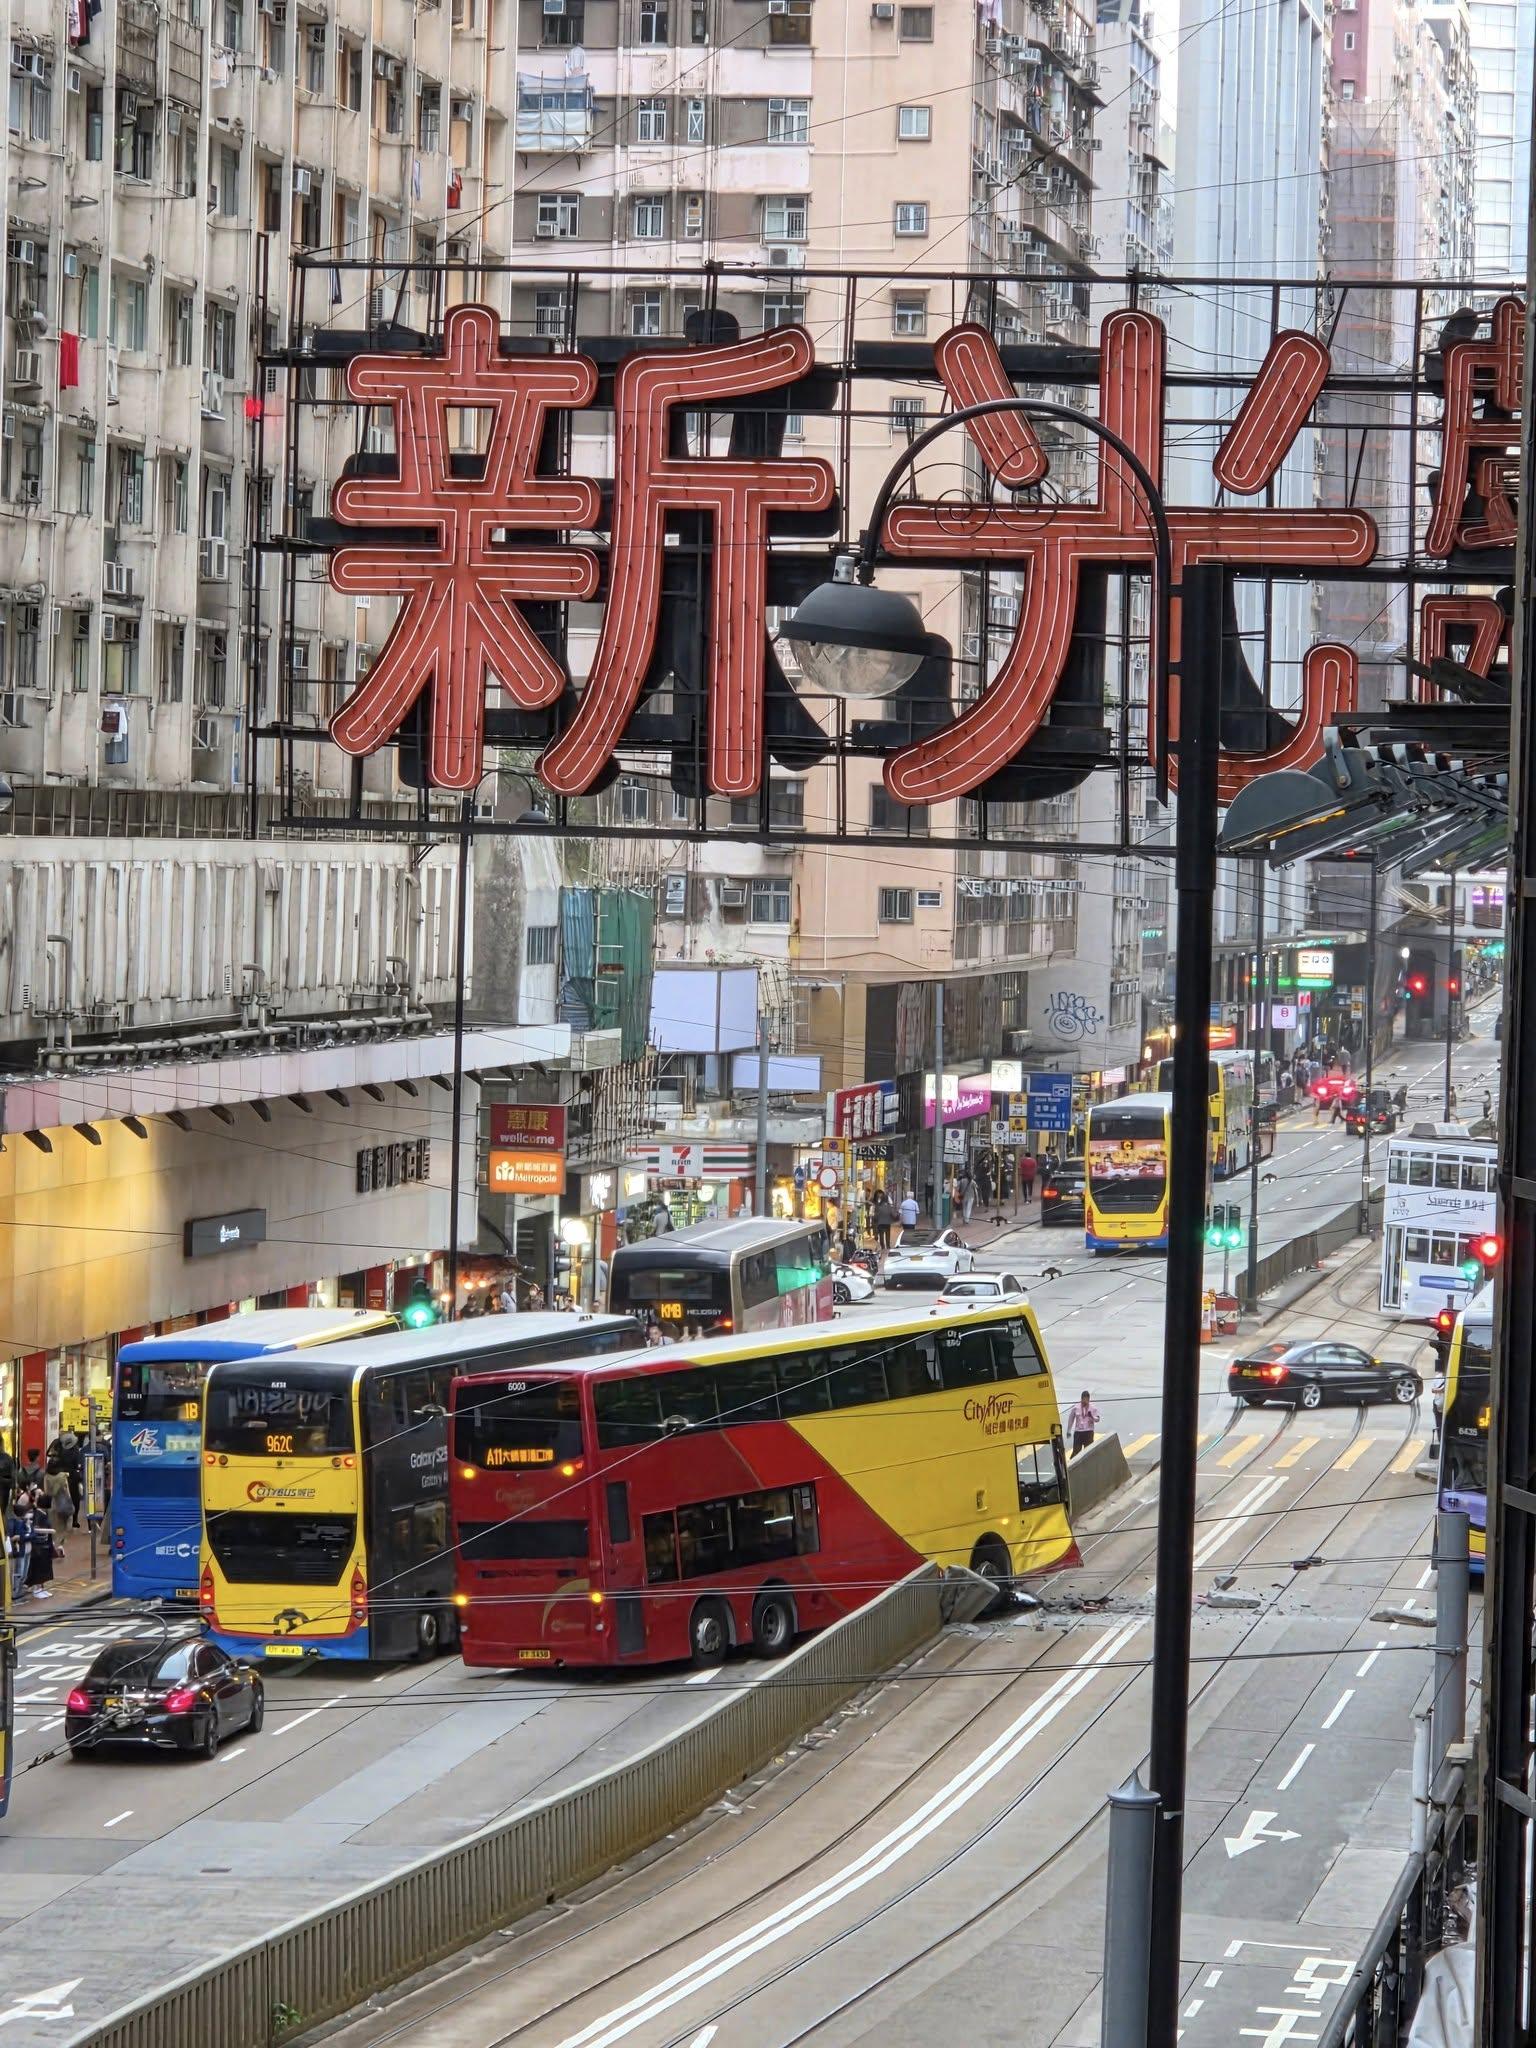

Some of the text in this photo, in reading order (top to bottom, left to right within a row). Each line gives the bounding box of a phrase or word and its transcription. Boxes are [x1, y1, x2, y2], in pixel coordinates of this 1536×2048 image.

[329, 304, 1378, 805] 新光
[267, 1435, 293, 1453] 962C
[487, 1448, 502, 1465] A11
[26, 1643, 106, 1658] BU
